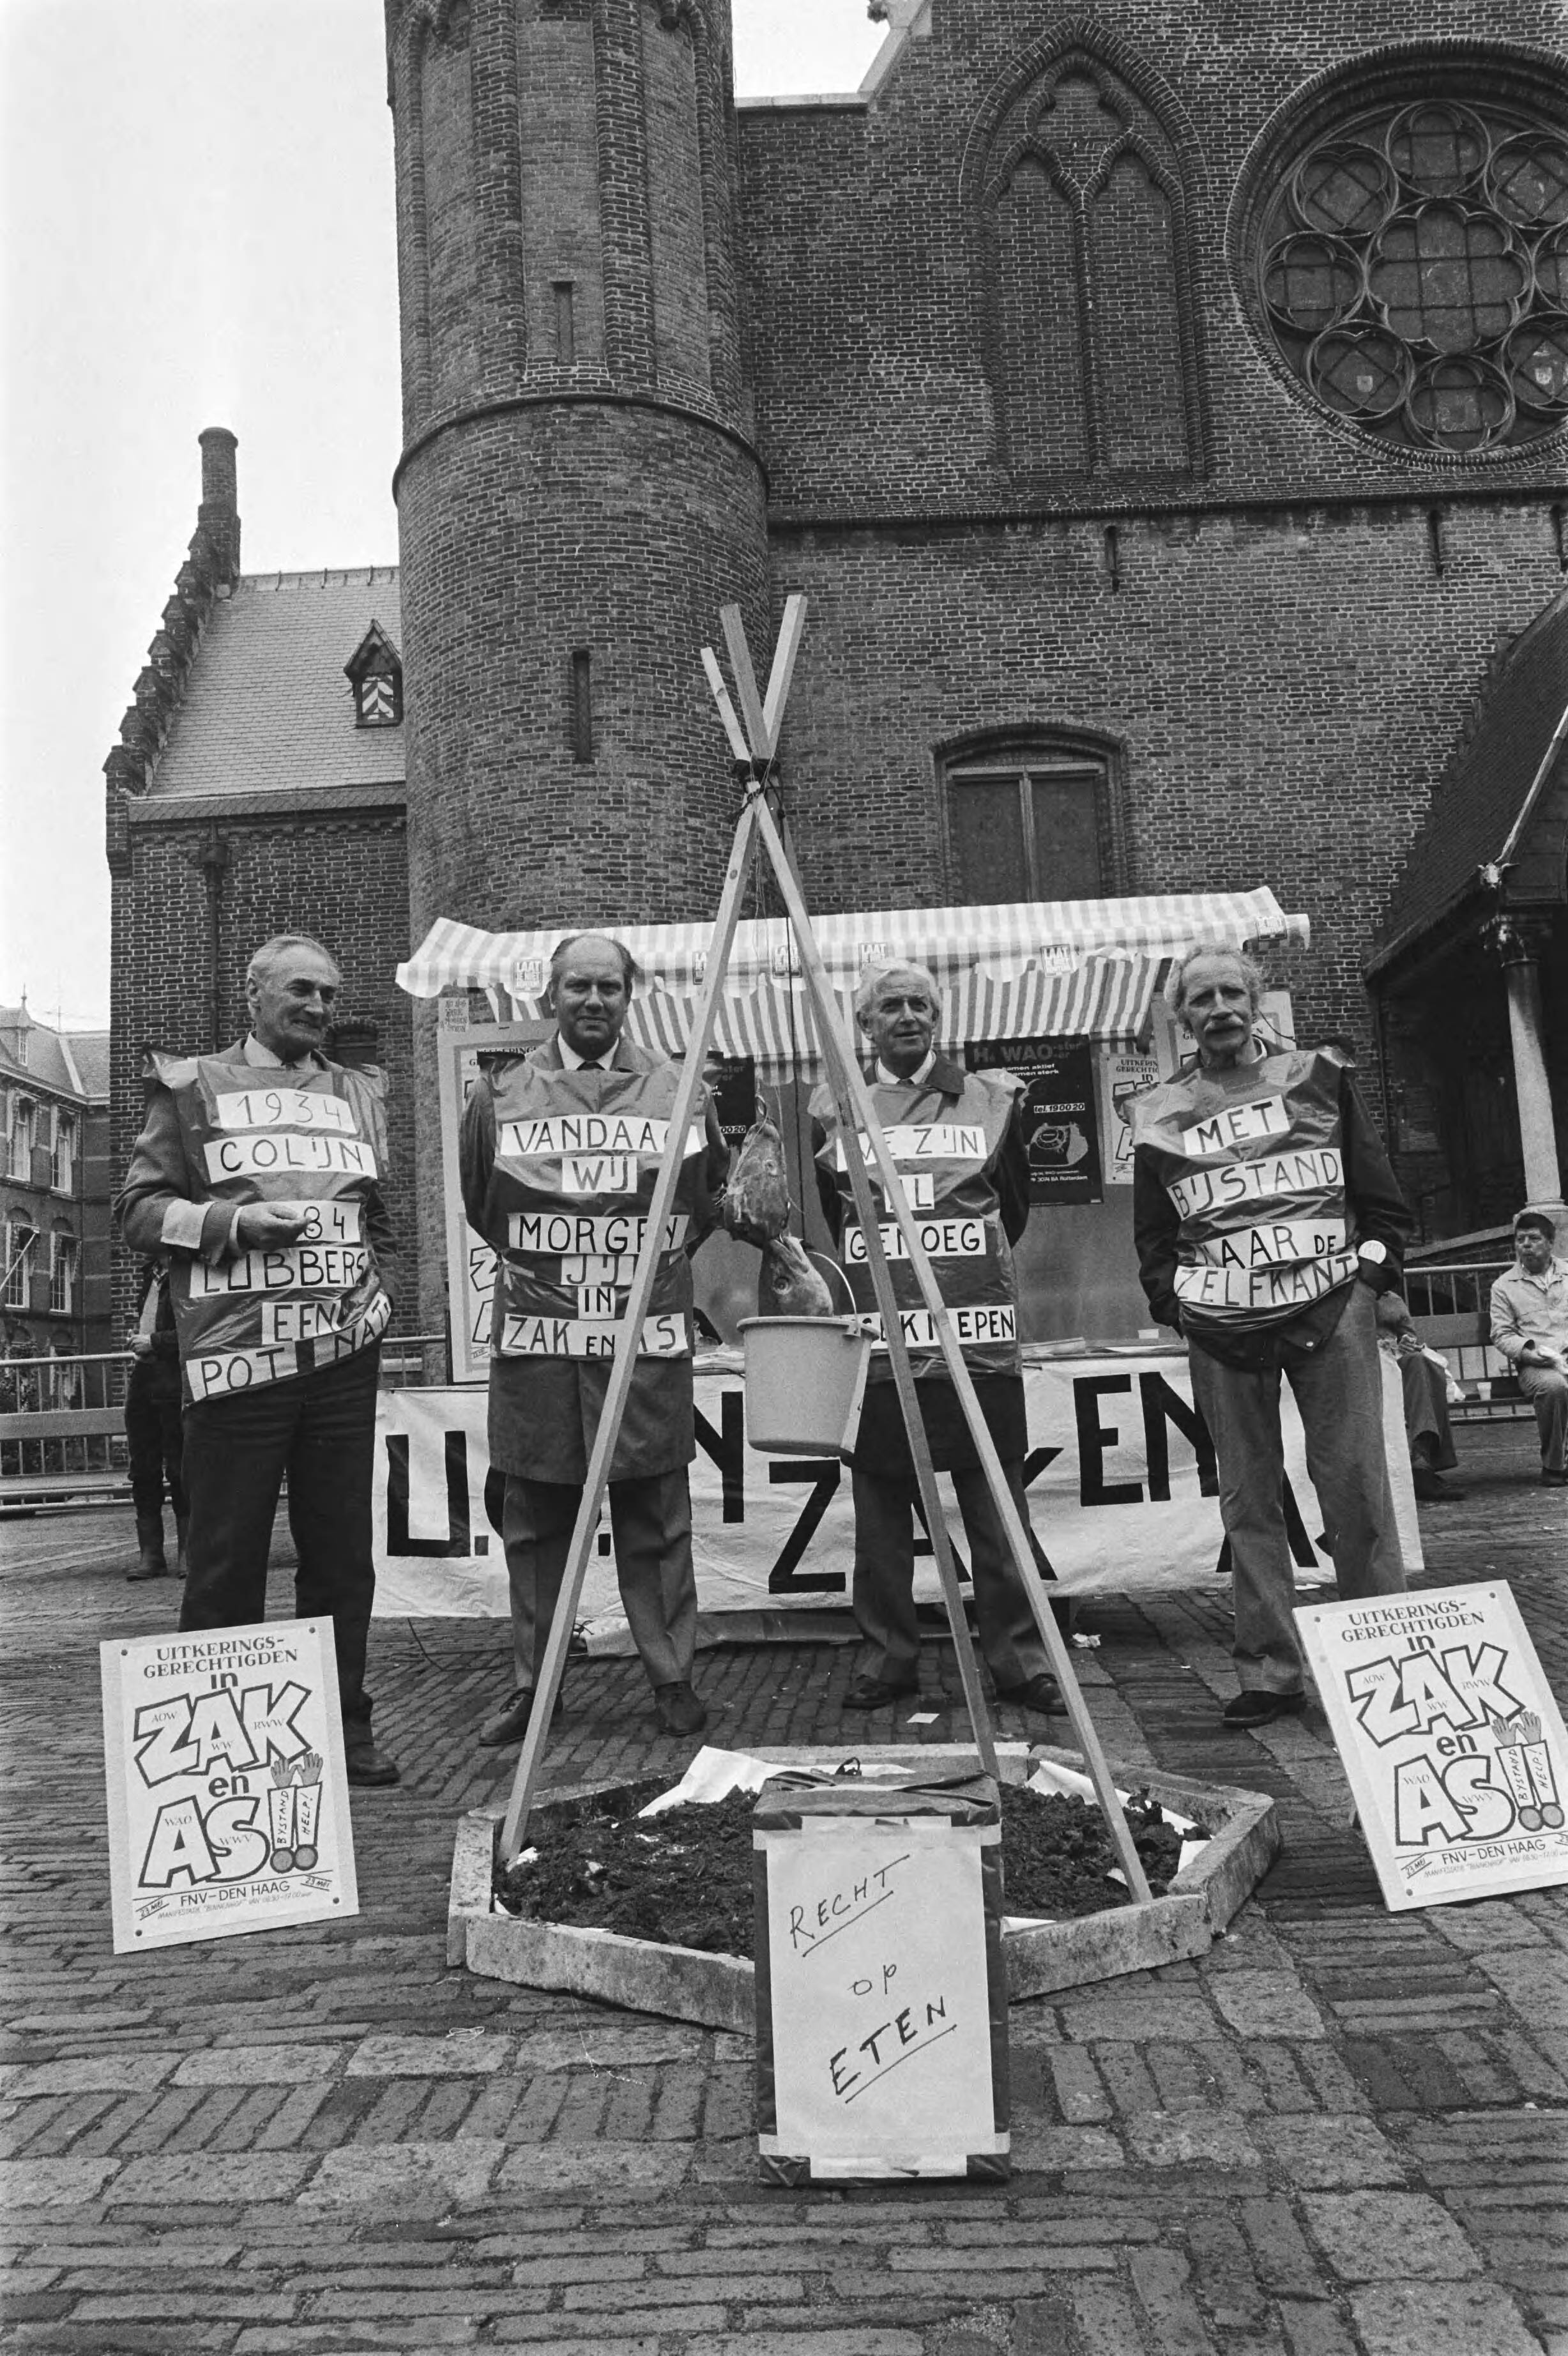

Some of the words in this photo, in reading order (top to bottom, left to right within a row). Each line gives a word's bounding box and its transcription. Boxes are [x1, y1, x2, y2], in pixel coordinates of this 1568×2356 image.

[237, 1092, 342, 1127] 1934
[513, 1118, 671, 1153] VANDAA
[1196, 1101, 1273, 1153] MET
[889, 1177, 932, 1210] L
[1313, 1234, 1336, 1255] DE
[204, 1250, 366, 1293] LUBBERS
[1176, 1254, 1353, 1307] ZELFKANT
[584, 1287, 611, 1313] IN
[505, 1315, 570, 1356] ZAK
[586, 1335, 615, 1356] EN
[201, 1346, 285, 1396] POT
[1341, 1611, 1485, 1642] GERECHTIGDEN
[1348, 1600, 1467, 1626] UITKERINGS-
[156, 1635, 285, 1661] UITKERINGS-
[1406, 1634, 1436, 1652] in
[143, 1649, 298, 1679] GERECHTIGDEN
[211, 1672, 238, 1690] in
[1344, 1641, 1526, 1749] ZAK
[132, 1680, 313, 1789] ZAK
[1436, 1733, 1479, 1757] en
[208, 1774, 250, 1798] en
[277, 1790, 289, 1844] BYSTAND
[299, 1792, 314, 1835] HELP!
[1508, 1839, 1546, 1856] HAAG
[251, 1880, 290, 1895] HAAG
[789, 1854, 910, 1949] RECHT
[829, 1996, 947, 2097] ETEN
